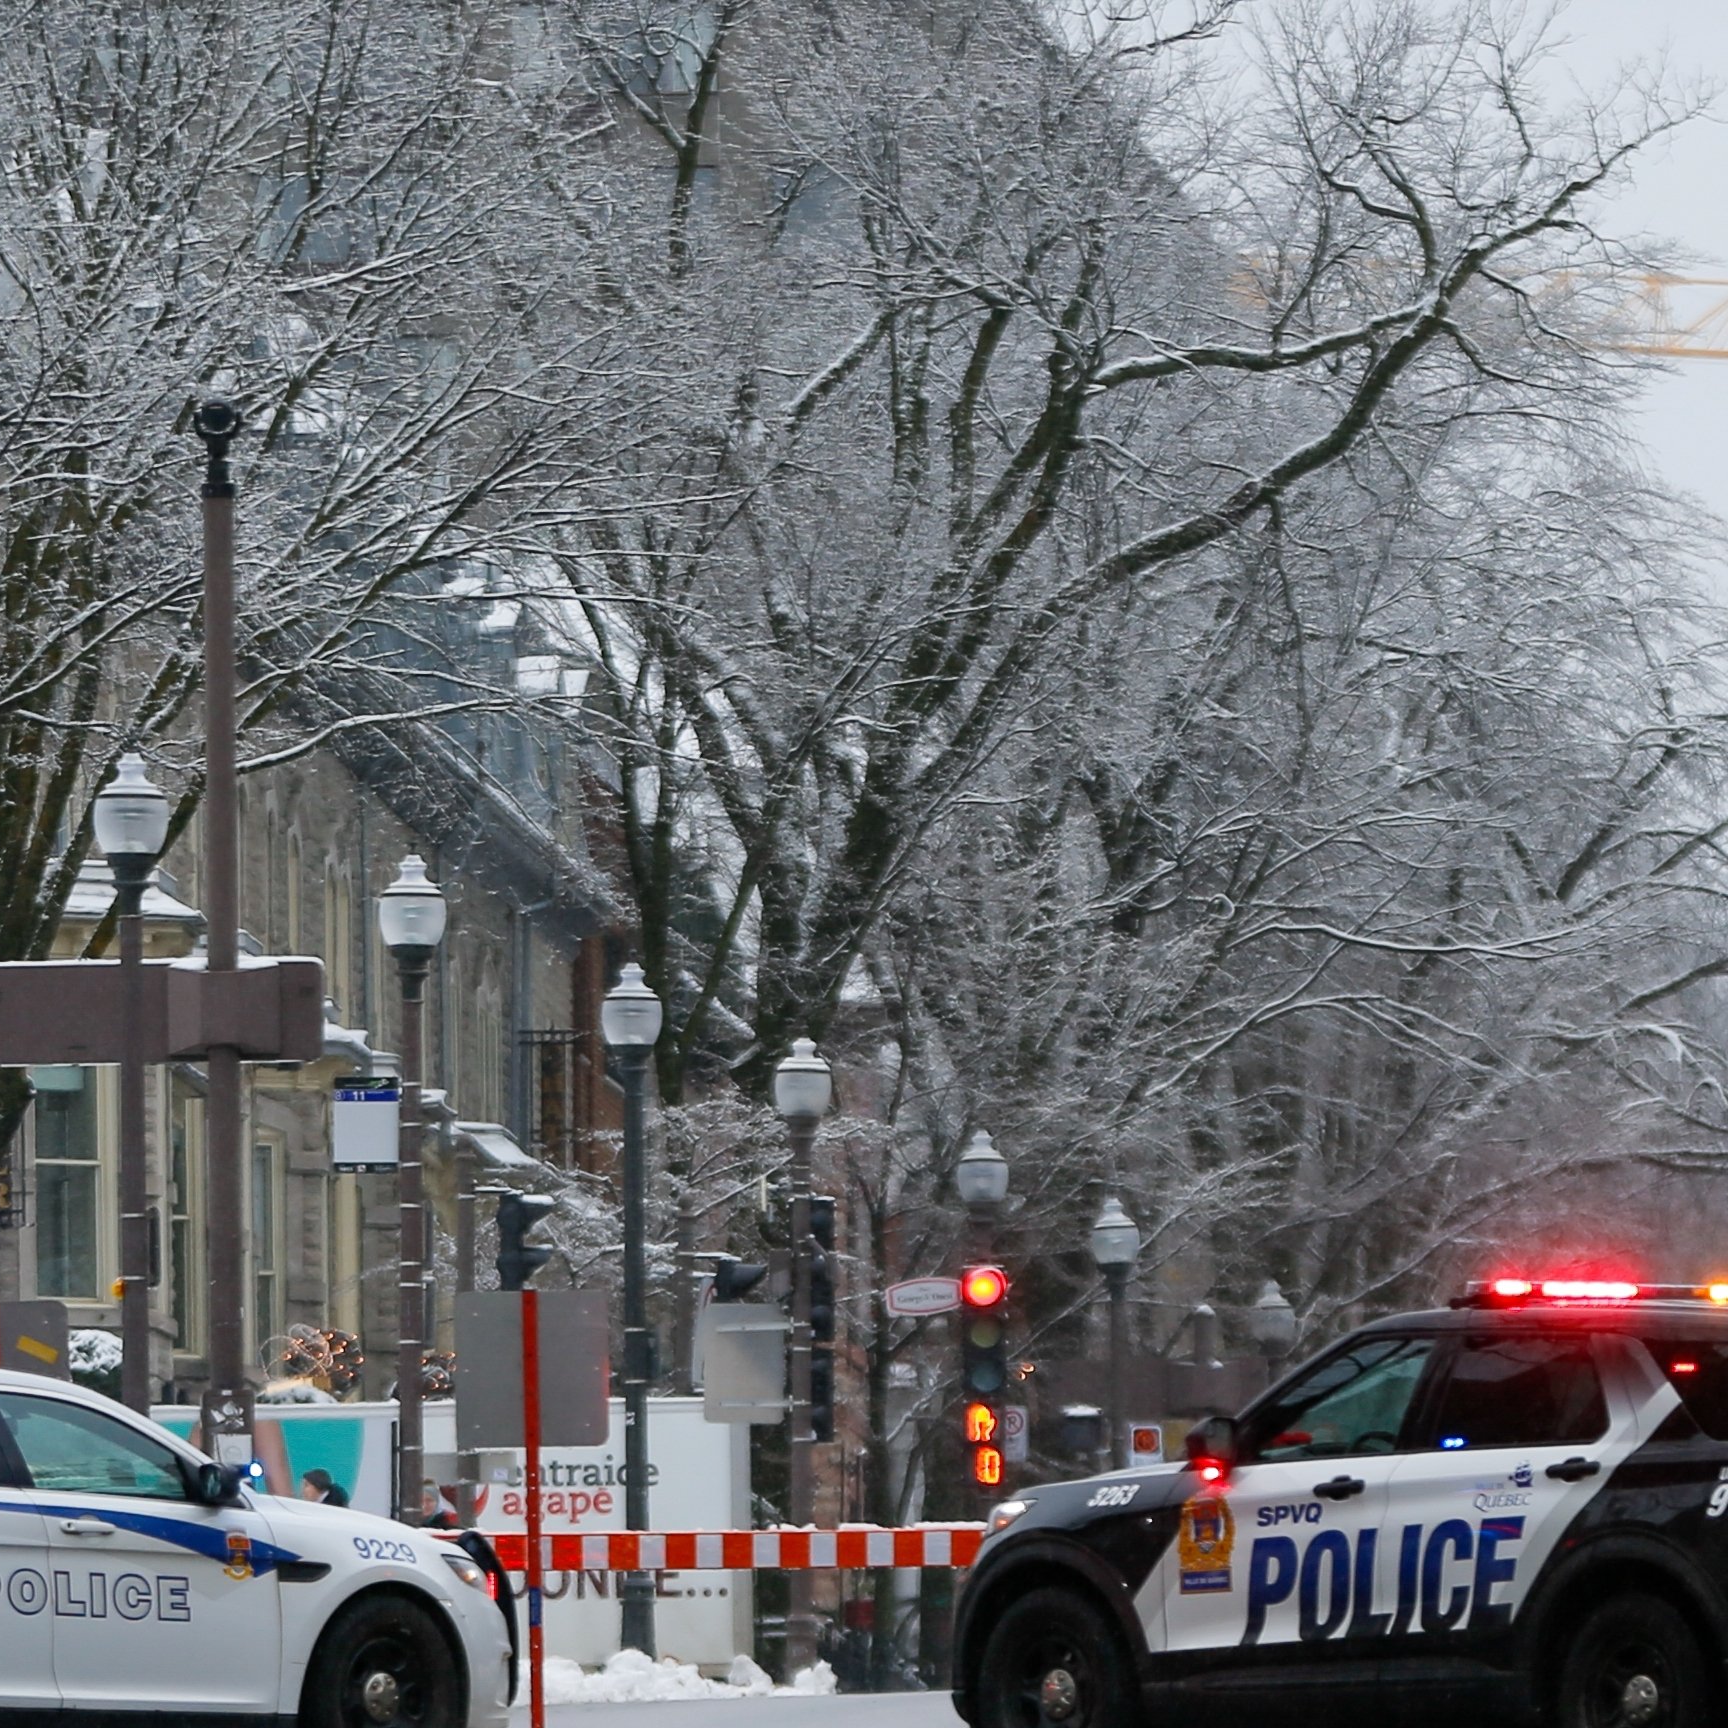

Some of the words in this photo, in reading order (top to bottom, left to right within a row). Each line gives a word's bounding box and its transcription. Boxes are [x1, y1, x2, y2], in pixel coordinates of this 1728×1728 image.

[1087, 1484, 1141, 1508] 3263
[1257, 1502, 1324, 1527] SPVQ
[353, 1536, 417, 1564] 9229
[1240, 1515, 1526, 1647] POLICE
